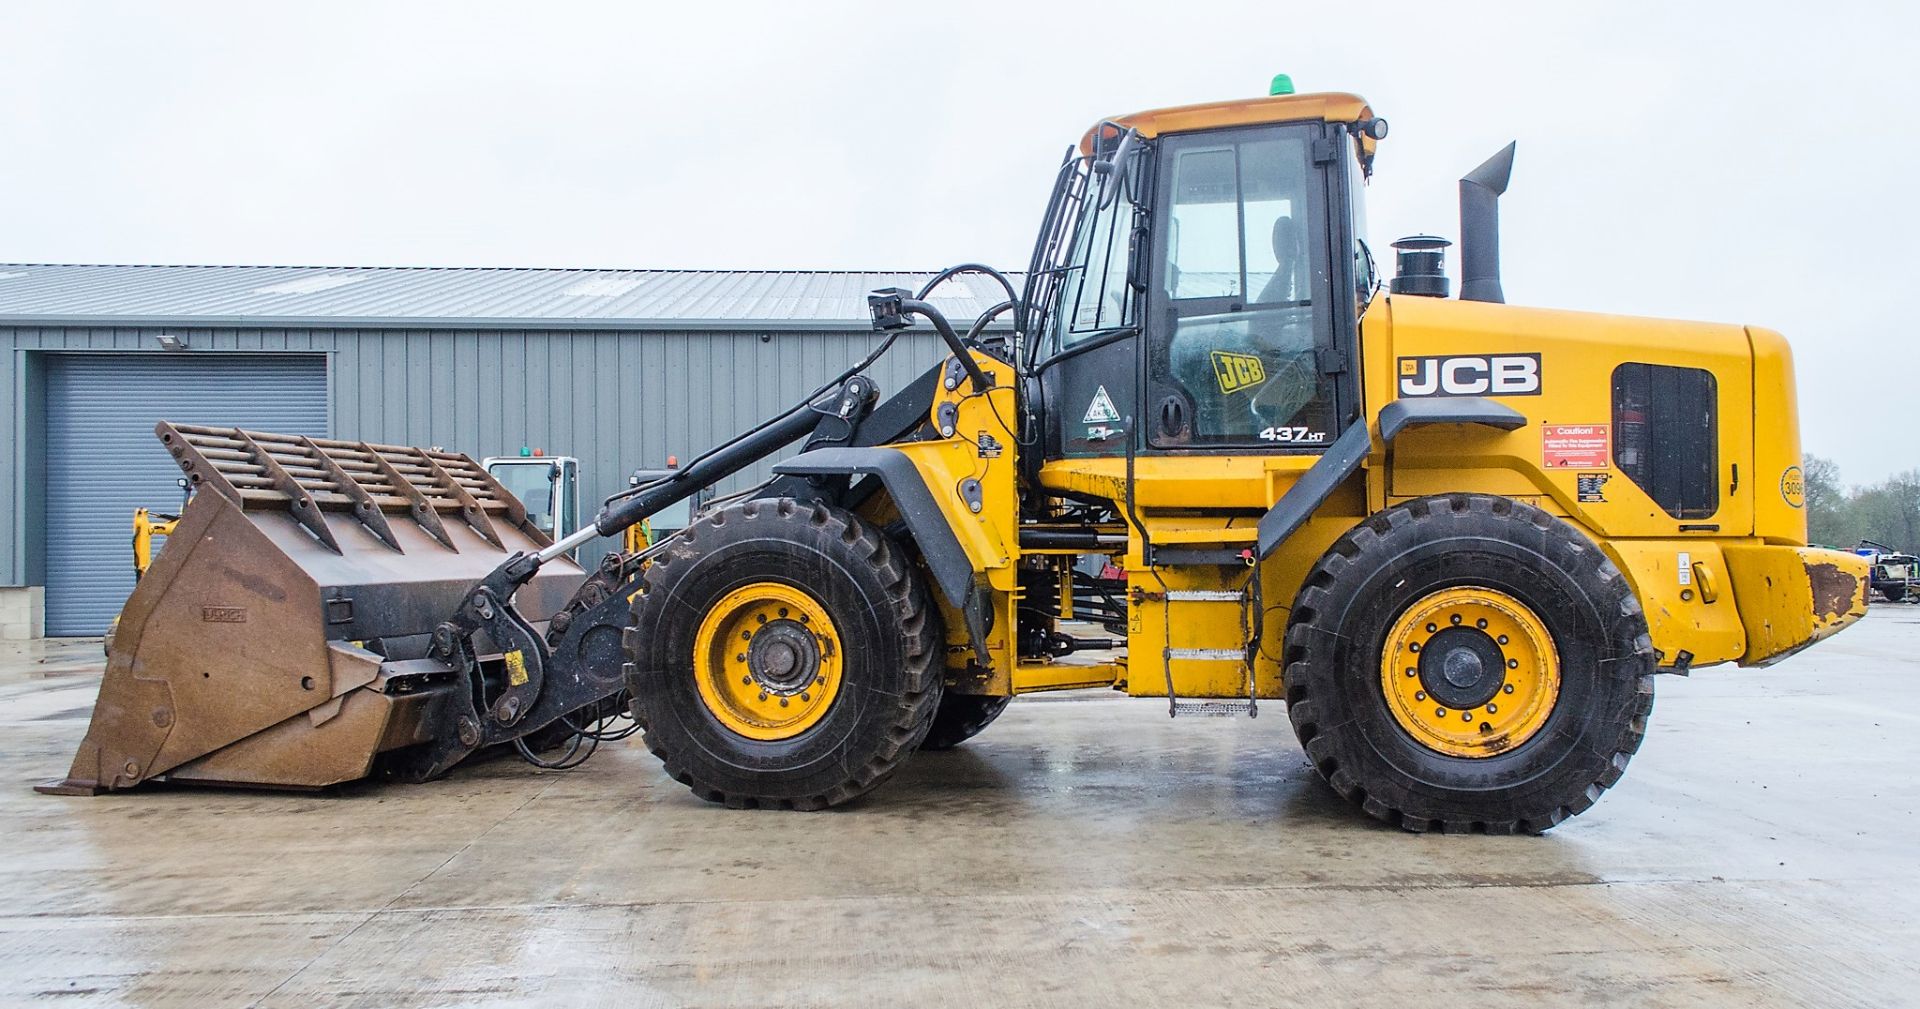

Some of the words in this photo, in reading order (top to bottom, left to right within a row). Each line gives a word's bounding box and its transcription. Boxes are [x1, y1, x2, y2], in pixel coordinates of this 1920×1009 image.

[1221, 355, 1261, 389] JCB
[1401, 356, 1539, 395] JCB
[1557, 427, 1593, 435] Caution!
